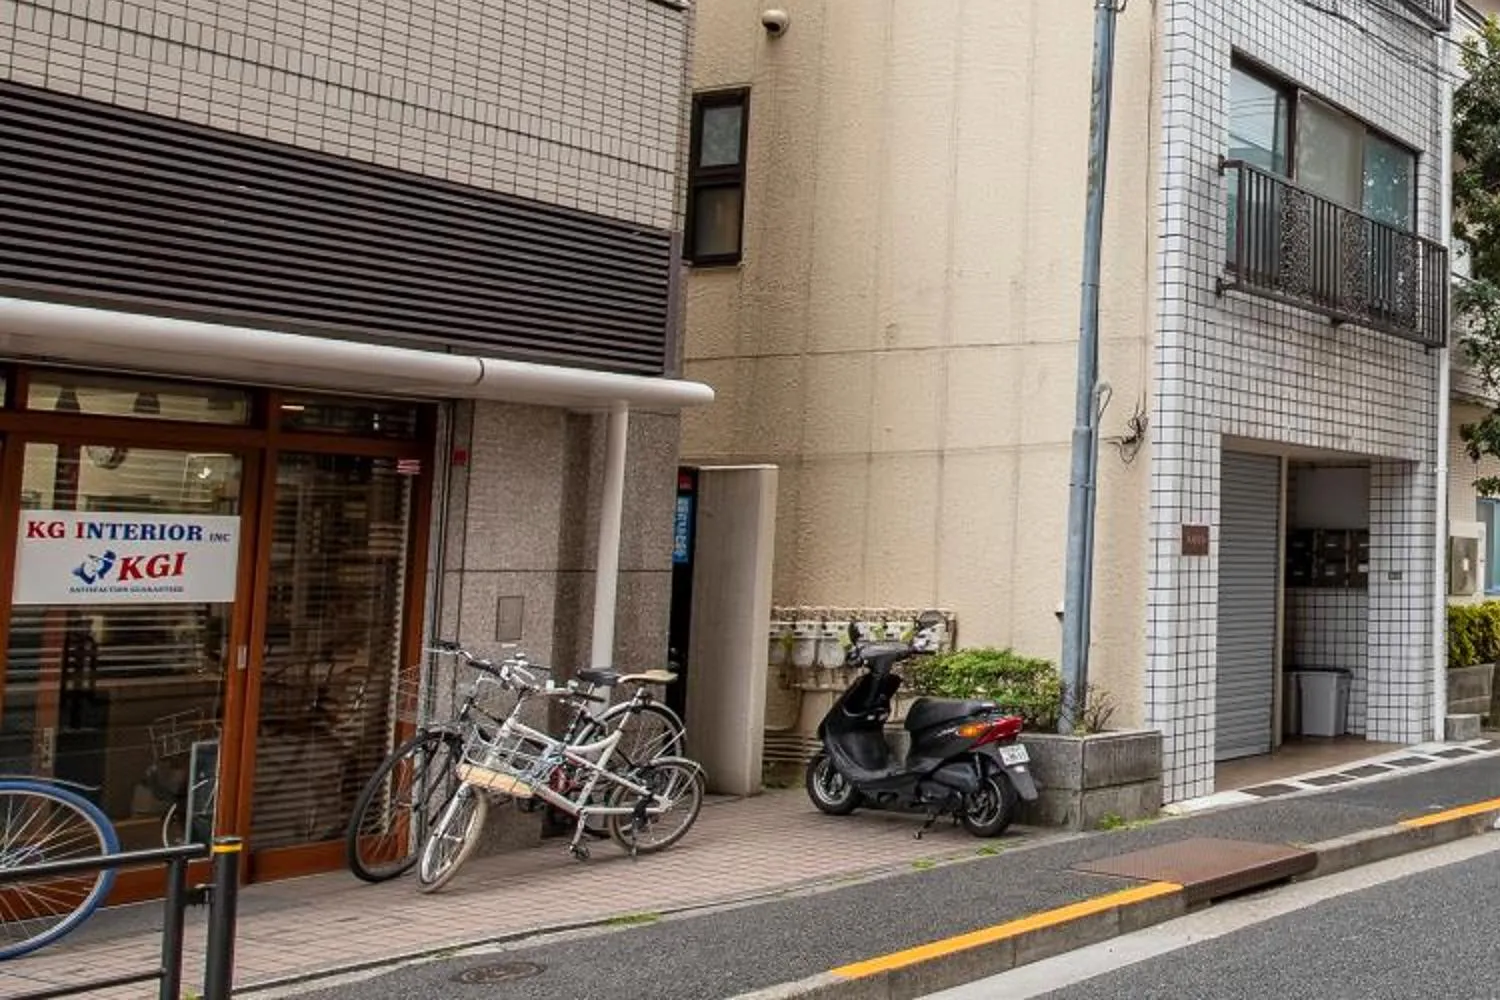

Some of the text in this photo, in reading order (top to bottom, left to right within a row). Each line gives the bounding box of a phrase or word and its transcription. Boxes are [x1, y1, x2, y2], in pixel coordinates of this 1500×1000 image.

[26, 520, 231, 543] KG INTERIOR INC
[117, 551, 188, 582] KGI
